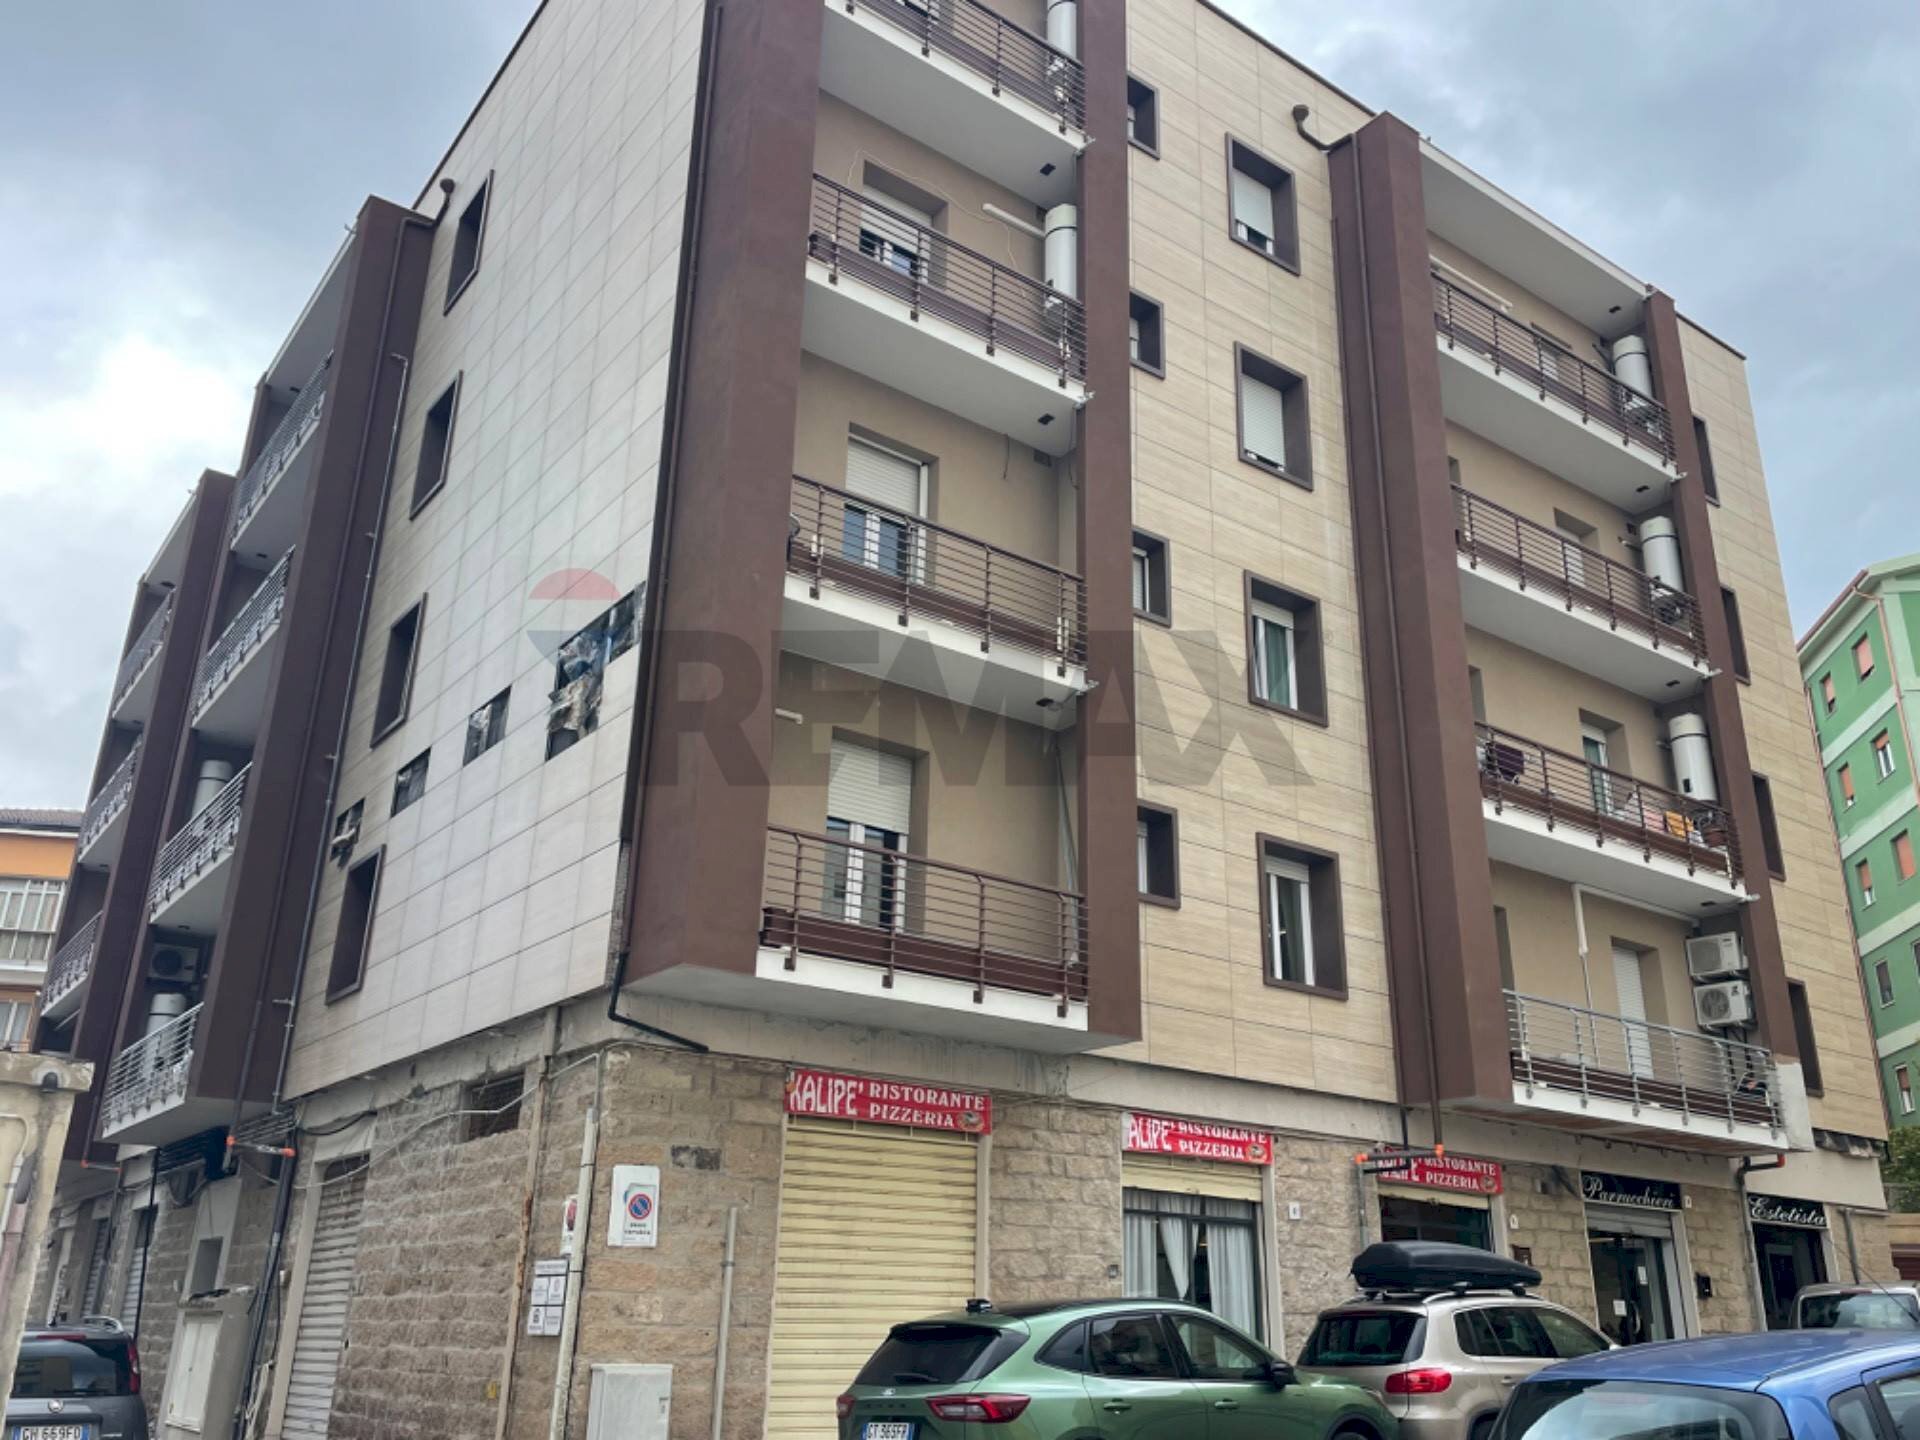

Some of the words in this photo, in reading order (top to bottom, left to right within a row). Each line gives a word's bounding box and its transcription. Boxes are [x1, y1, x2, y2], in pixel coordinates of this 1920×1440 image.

[870, 1083, 984, 1111] RISTORANTE
[870, 1102, 954, 1127] PIZZERIA
[1179, 1138, 1245, 1160] PIZZERIA
[1425, 1171, 1479, 1190] PIZZERIA
[1748, 1196, 1827, 1225] Estetista
